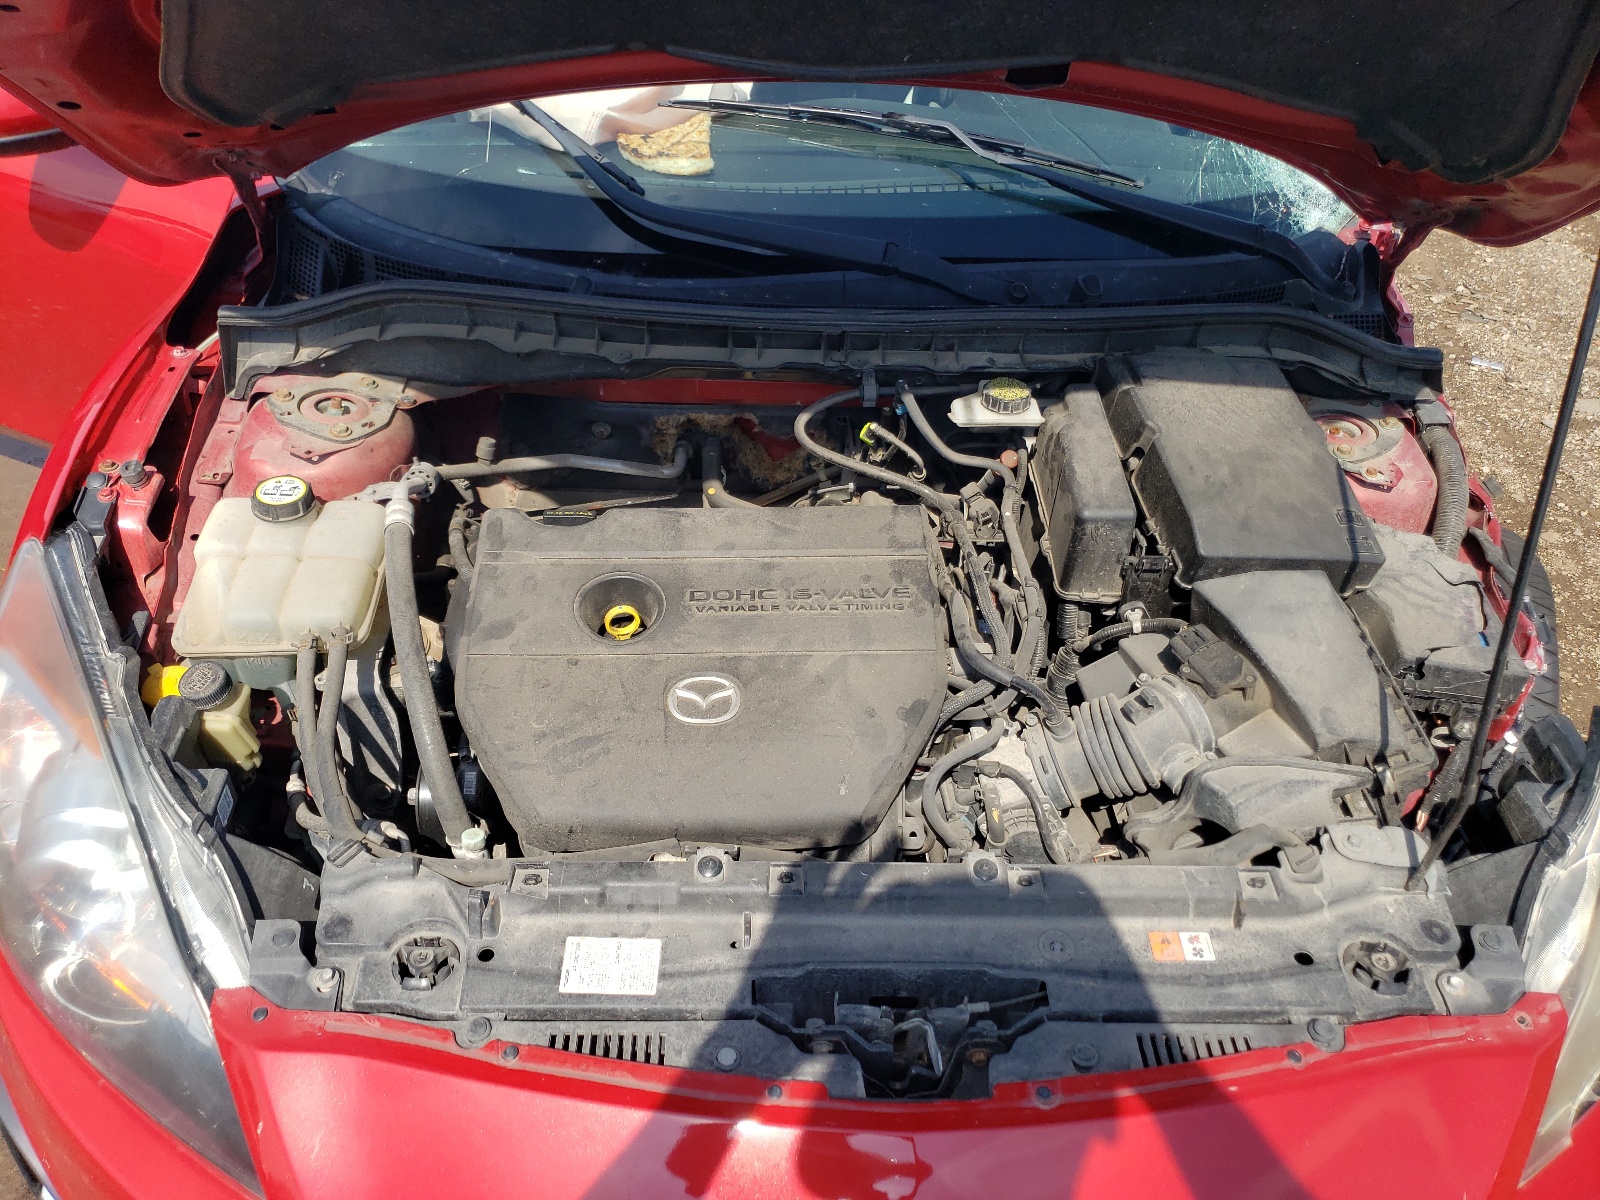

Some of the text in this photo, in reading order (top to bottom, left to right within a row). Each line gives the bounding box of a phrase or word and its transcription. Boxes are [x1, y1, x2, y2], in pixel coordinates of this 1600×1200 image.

[689, 586, 911, 602] DOHC 16-VALVE
[695, 603, 905, 613] VARIABLE VALVE TIMING
